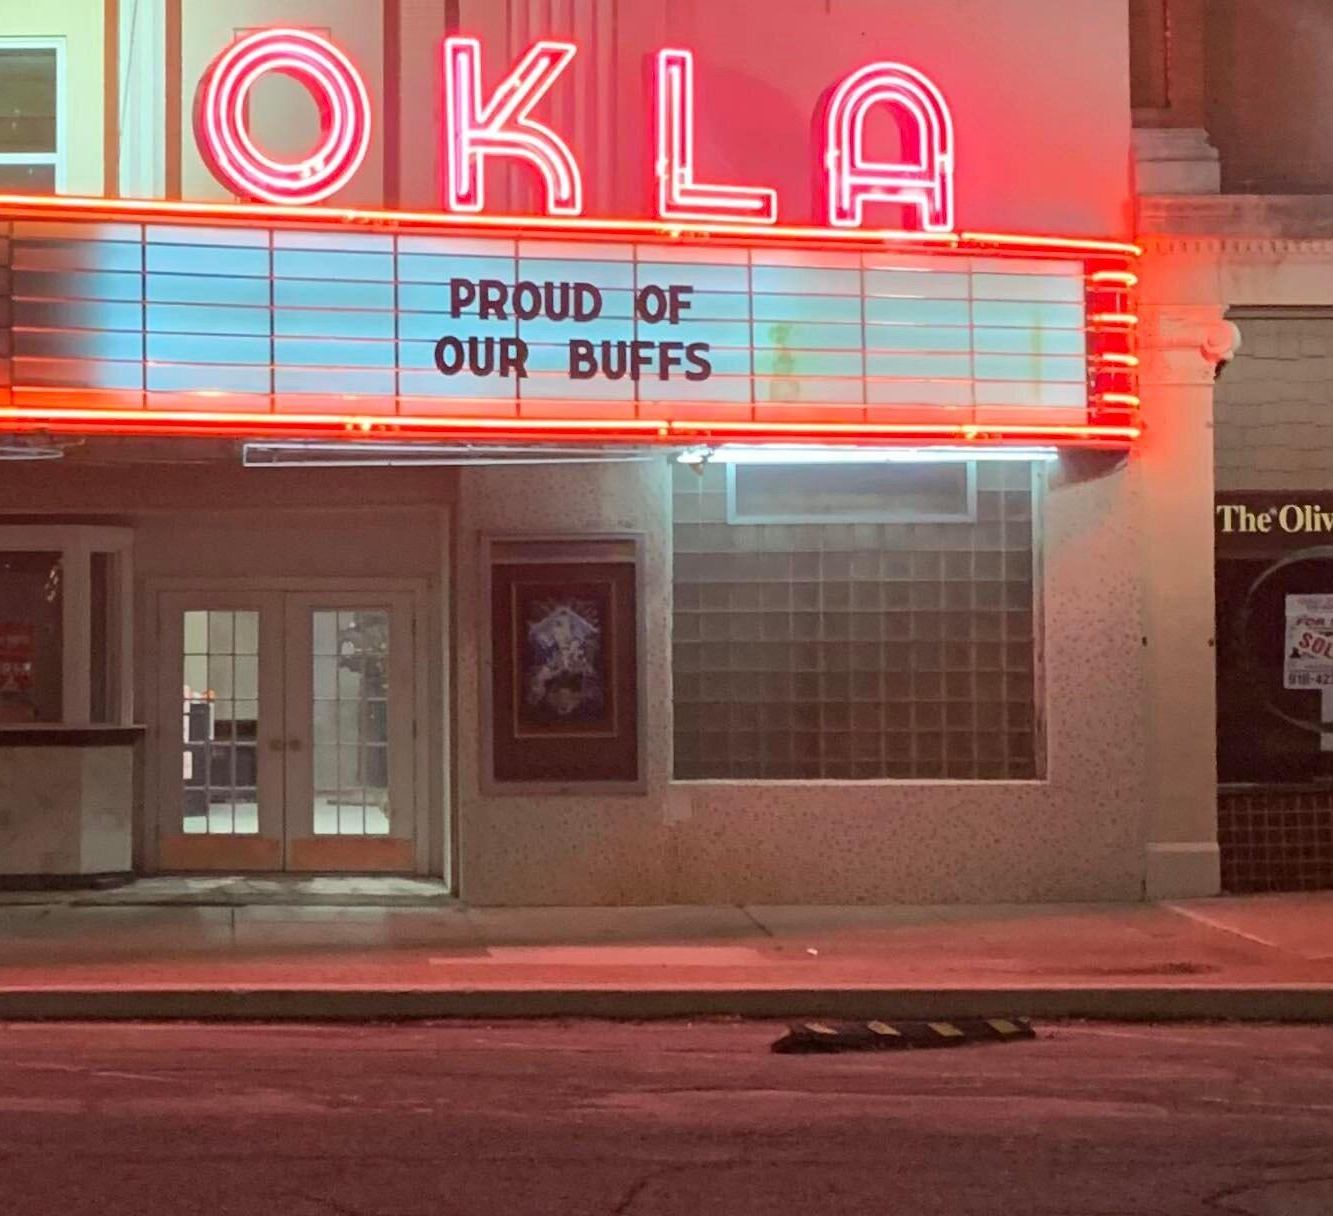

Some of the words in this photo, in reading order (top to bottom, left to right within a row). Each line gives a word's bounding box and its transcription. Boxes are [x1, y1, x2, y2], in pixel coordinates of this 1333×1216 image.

[197, 27, 957, 233] OKLA
[450, 277, 603, 323] PROUD
[636, 284, 694, 325] OF
[434, 335, 529, 379] OUR
[569, 339, 712, 382] BUFFS
[1216, 505, 1273, 533] The
